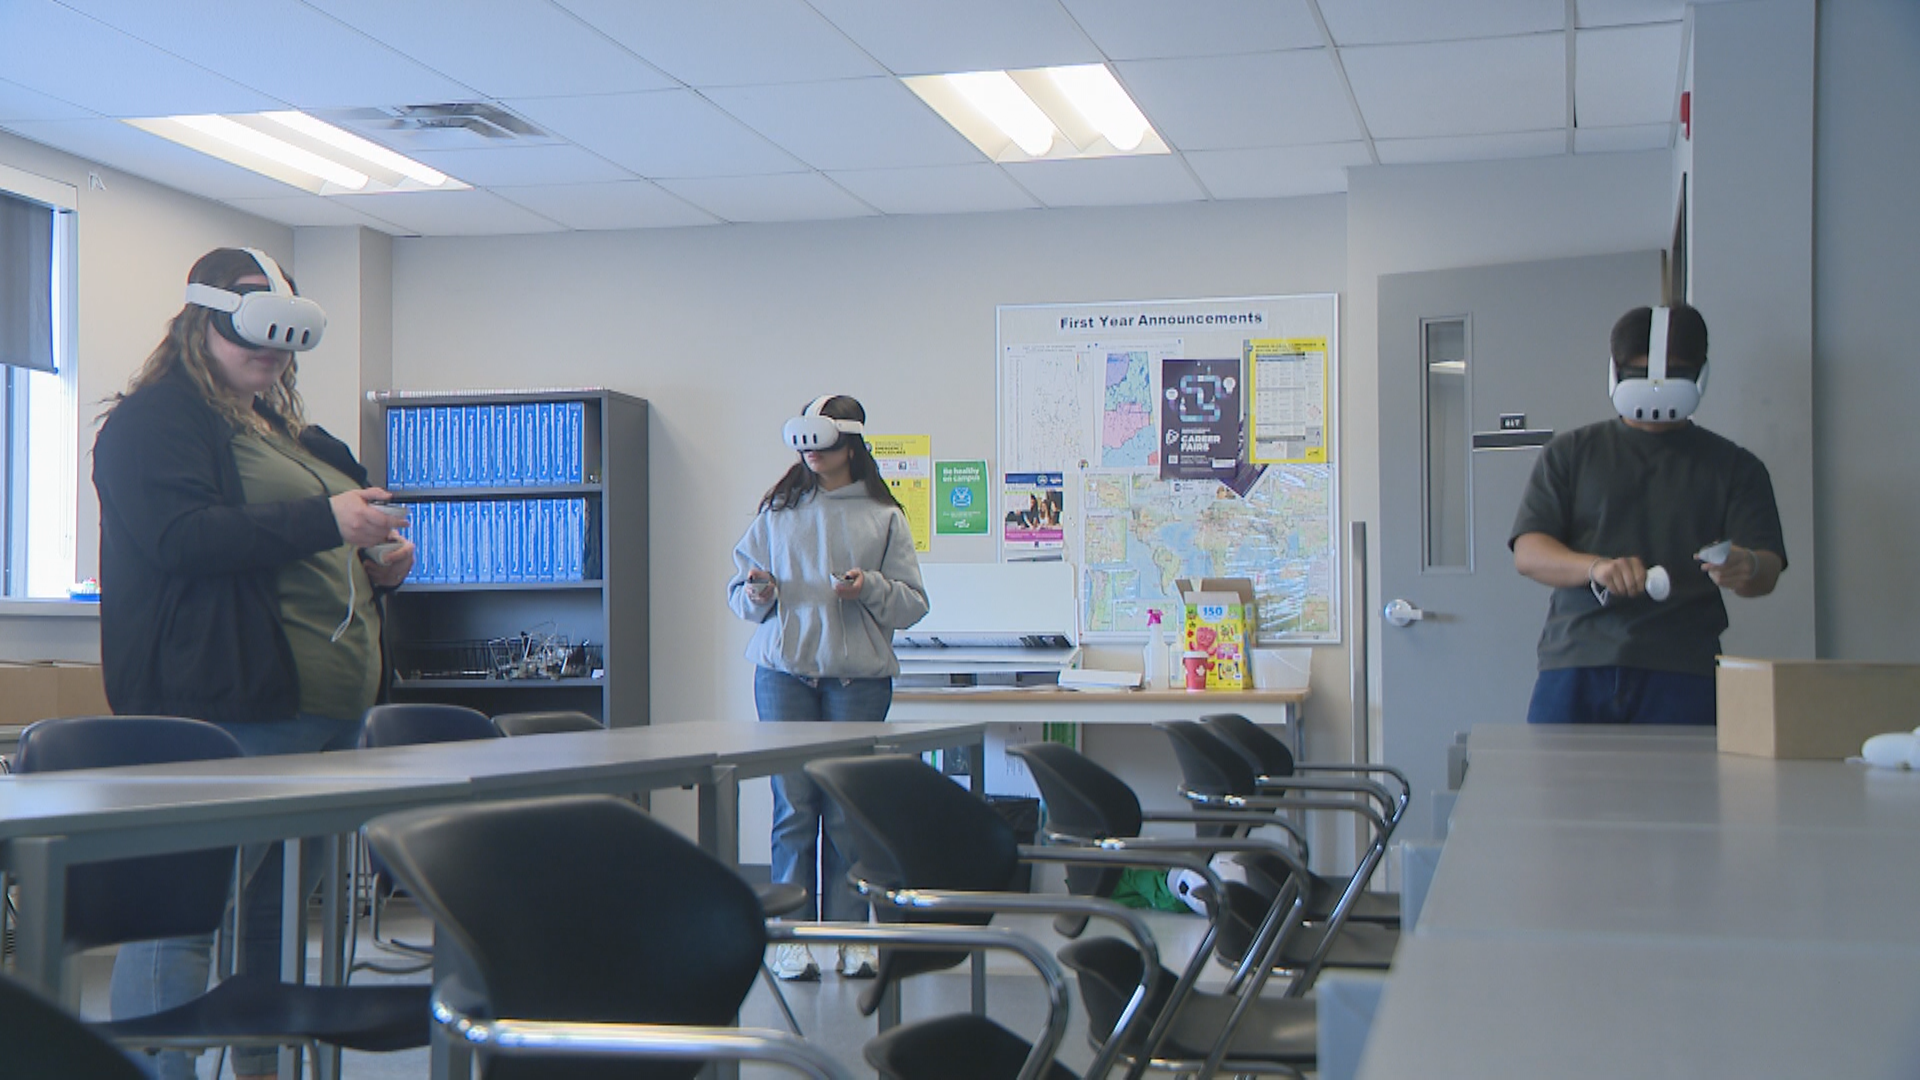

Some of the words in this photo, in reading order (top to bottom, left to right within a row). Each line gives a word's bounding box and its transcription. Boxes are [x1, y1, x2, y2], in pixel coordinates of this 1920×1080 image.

[1060, 317, 1094, 329] First
[1100, 315, 1134, 327] Year
[1138, 312, 1262, 326] Announcements
[1181, 435, 1221, 444] CAREER
[1181, 443, 1210, 452] FAIRS
[953, 467, 980, 477] healthy
[953, 475, 980, 483] campus
[1203, 606, 1223, 616] 150
